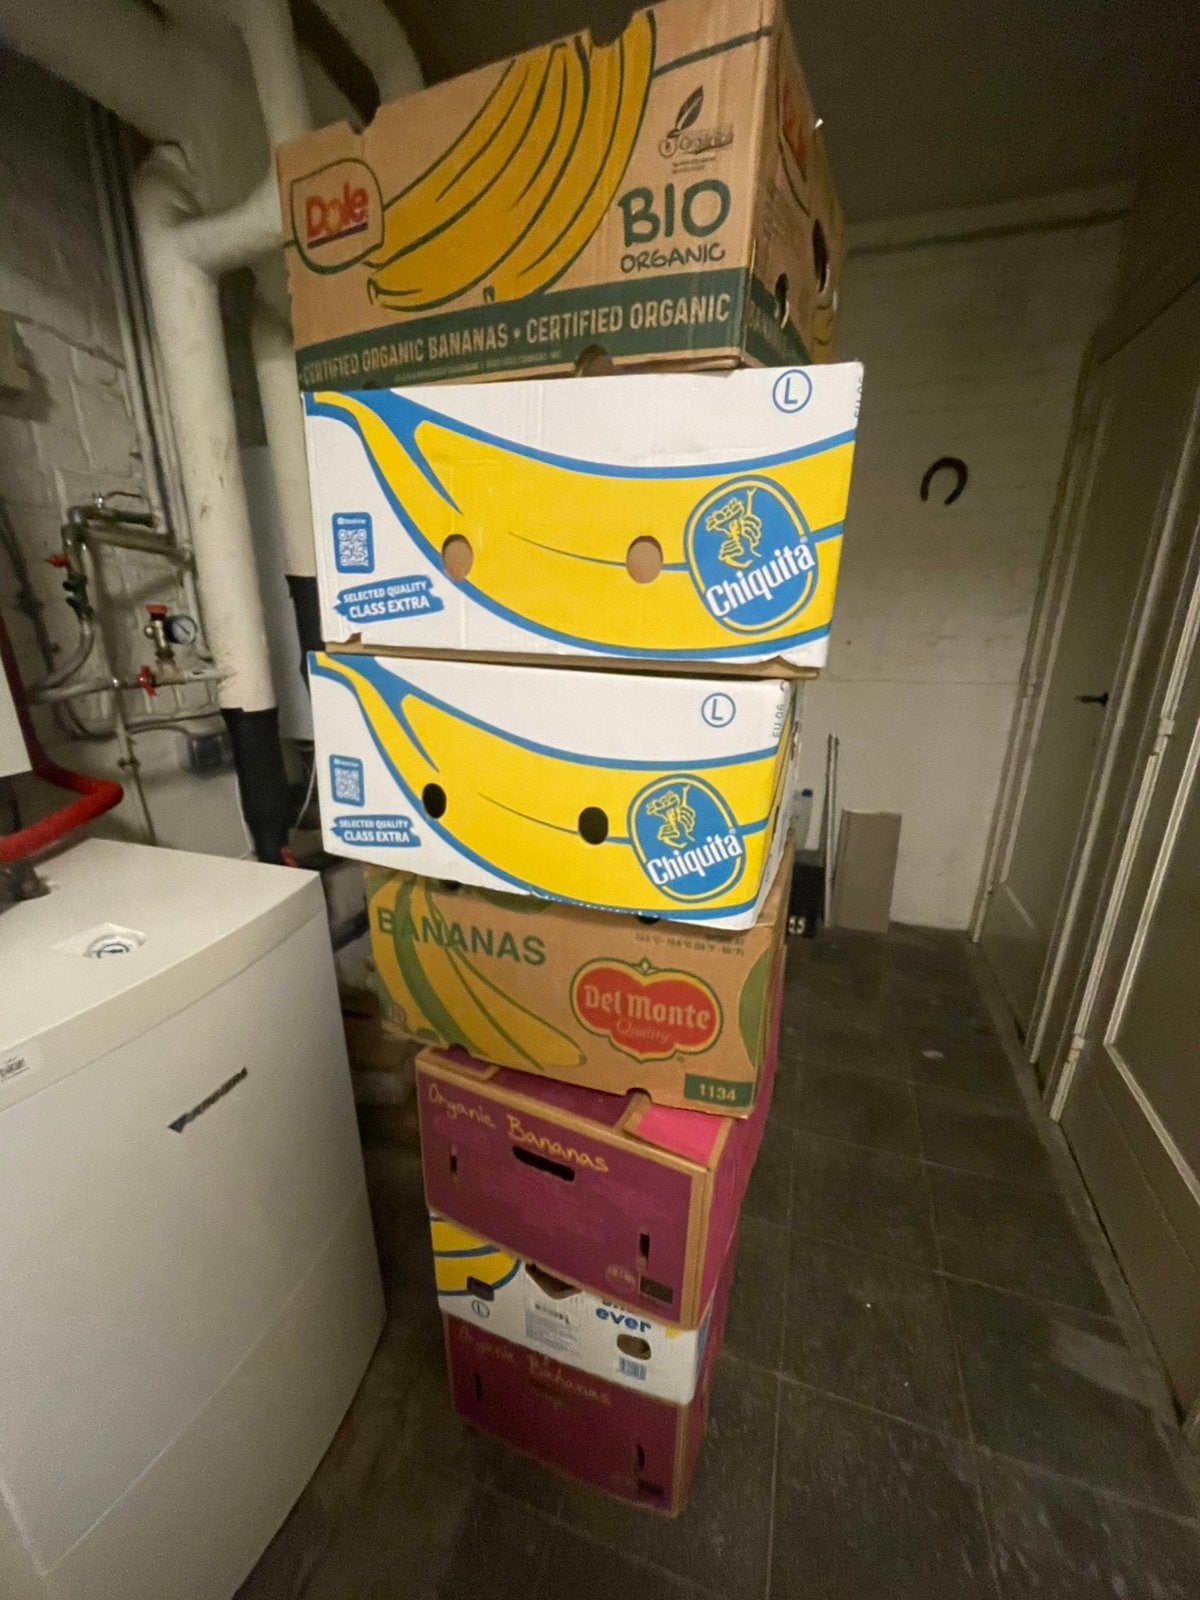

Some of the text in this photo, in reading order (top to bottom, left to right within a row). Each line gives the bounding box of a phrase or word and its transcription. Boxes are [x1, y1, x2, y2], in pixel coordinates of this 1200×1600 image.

[305, 181, 369, 239] Dole
[617, 179, 731, 247] BIO
[620, 243, 726, 273] ORGANIC
[361, 338, 425, 373] ORGANIC
[427, 323, 508, 360] BANANAS
[525, 306, 623, 344] CERTIFIED
[629, 293, 731, 330] ORGANIC
[343, 581, 427, 603] SELECTED QUALITY
[705, 540, 816, 618] Chiquita
[349, 595, 430, 618] CLASS EXTRA
[338, 819, 409, 830] SELECTED QUALITY
[344, 830, 410, 843] CLASS EXTRA
[646, 833, 743, 885] Chiquita
[377, 908, 547, 966] BANANAS
[584, 985, 711, 1030] Del Monte
[699, 1083, 736, 1102] 1134
[429, 1083, 609, 1173] Organic Bananas
[595, 1307, 652, 1333] ever
